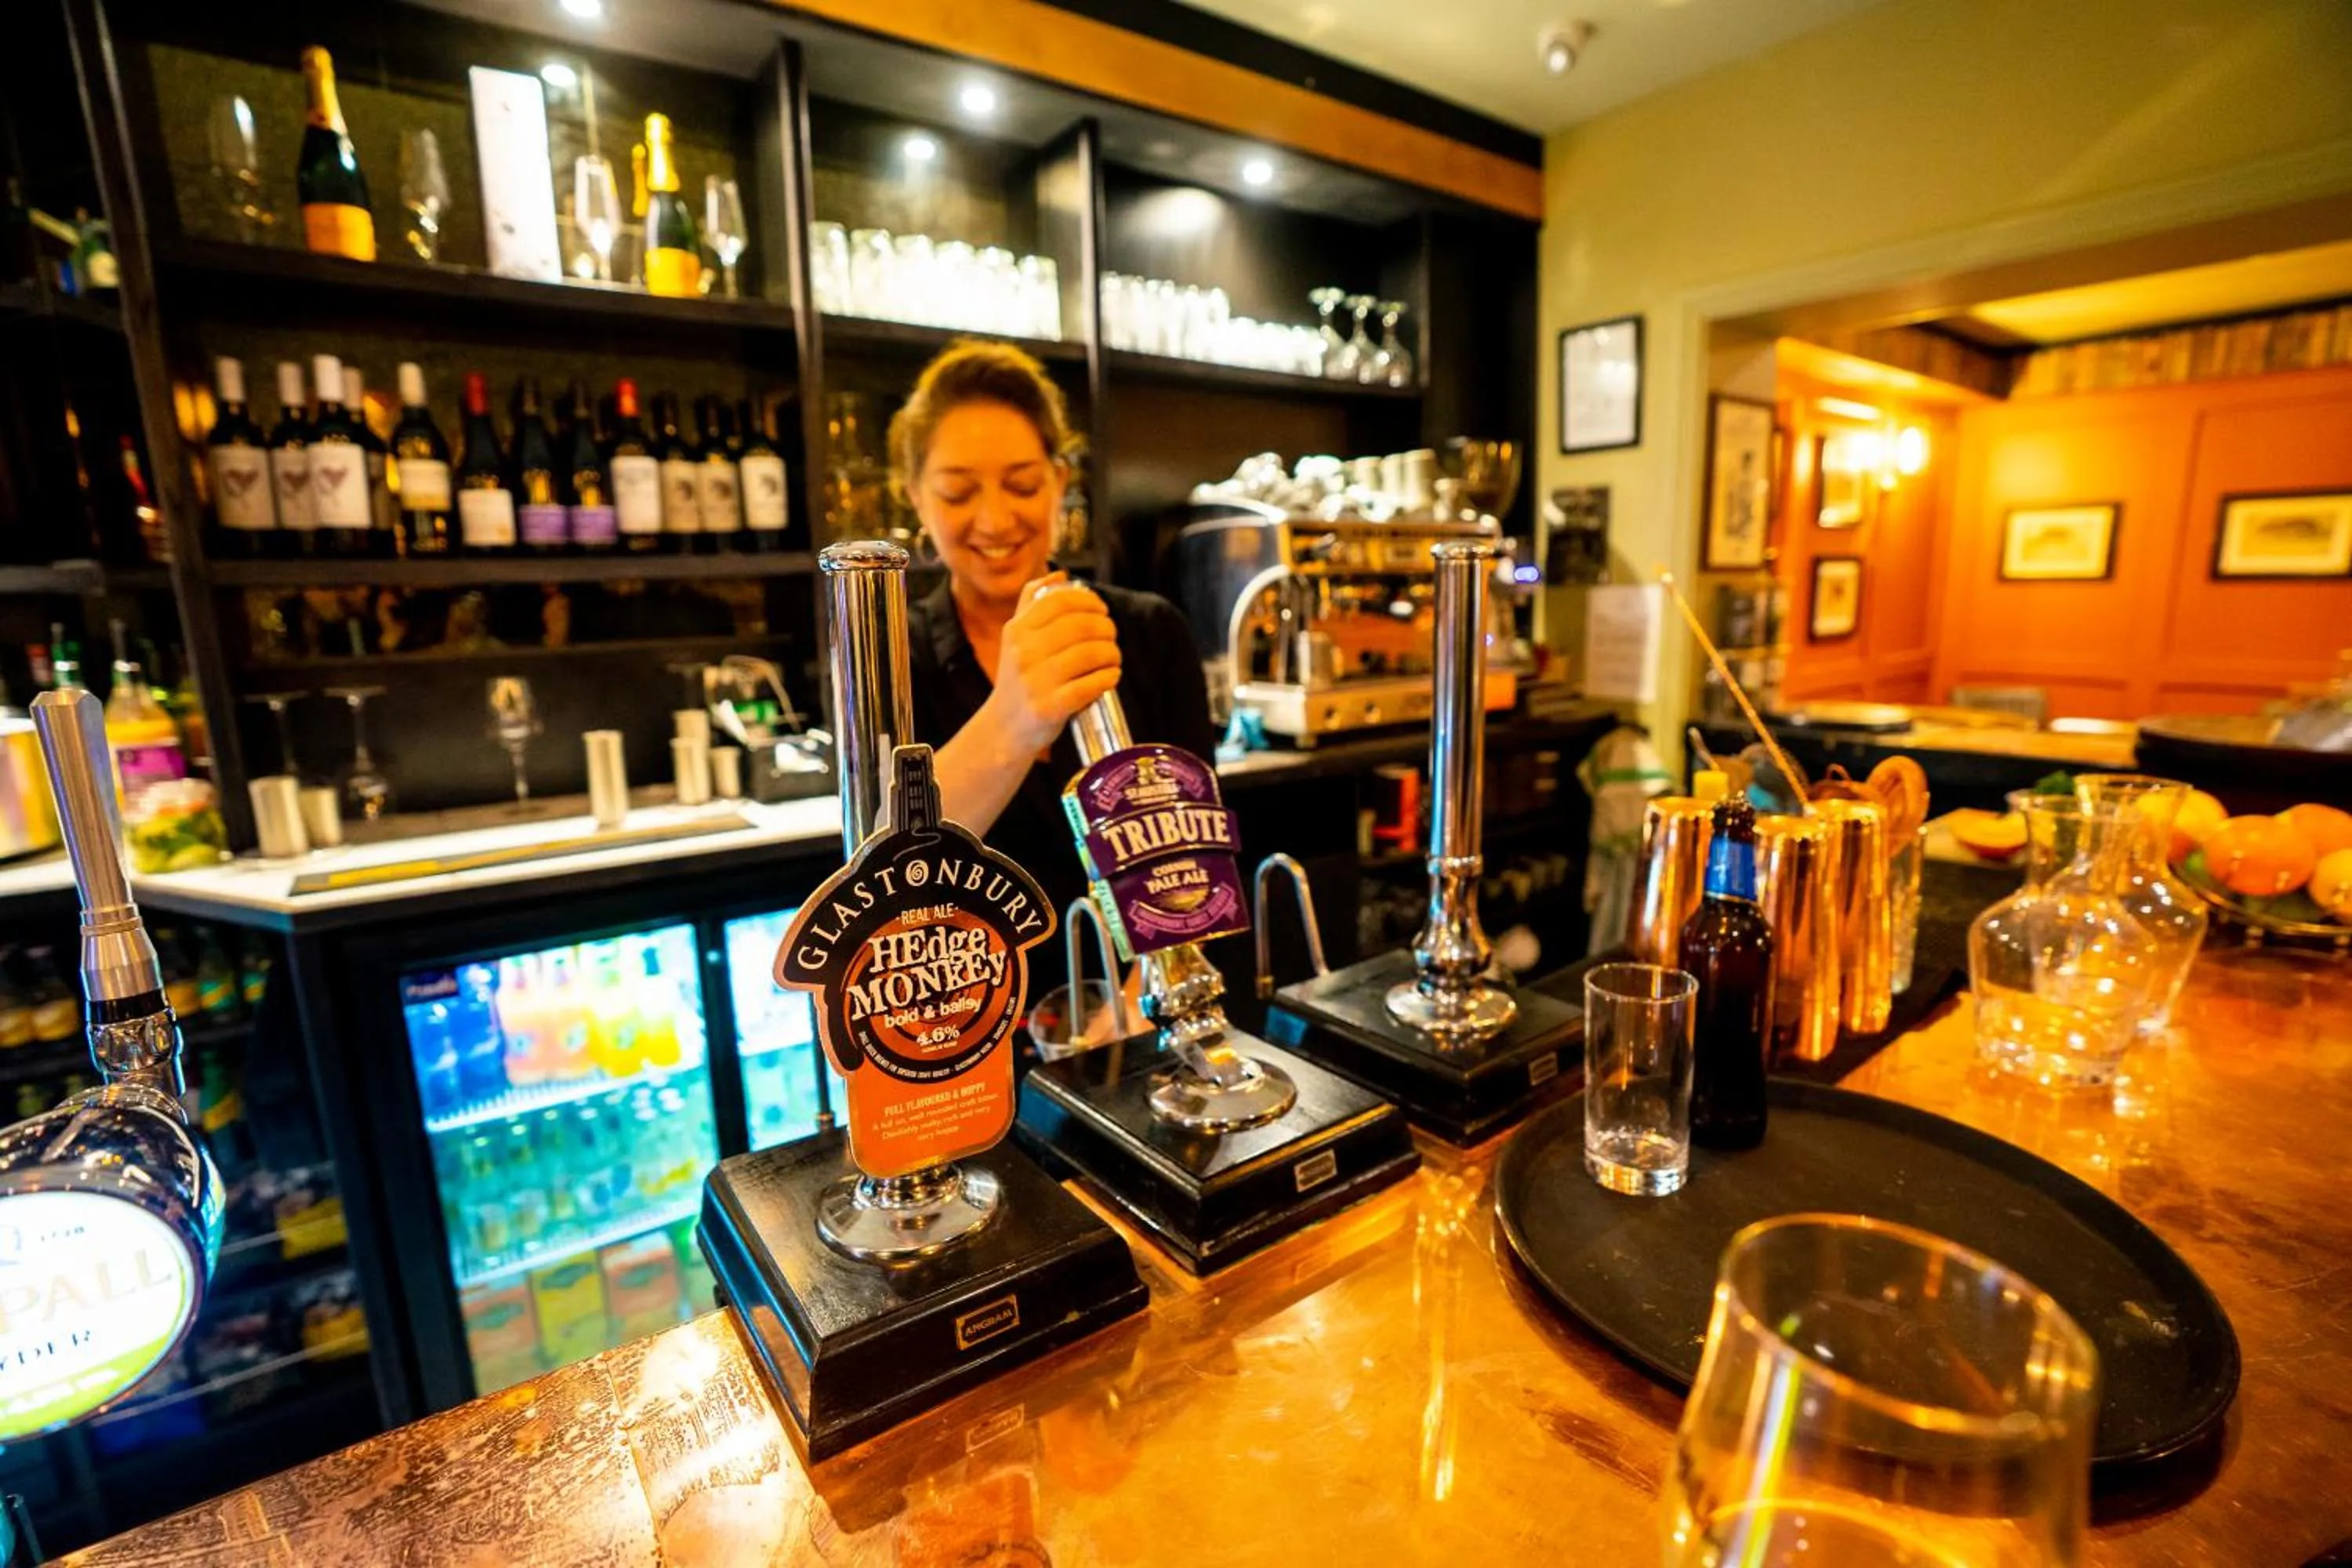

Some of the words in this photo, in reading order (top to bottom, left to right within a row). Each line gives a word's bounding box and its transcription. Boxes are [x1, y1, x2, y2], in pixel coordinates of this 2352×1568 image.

[1102, 809, 1231, 862] TRIBUTE
[1144, 873, 1181, 894] PALE
[1182, 867, 1209, 885] ALE
[797, 858, 1041, 970] GLASTONBURY
[902, 909, 931, 925] REAL
[933, 903, 955, 919] ALE
[884, 1007, 919, 1028] bold
[924, 1004, 936, 1019] &
[916, 1024, 960, 1047] 4.6%
